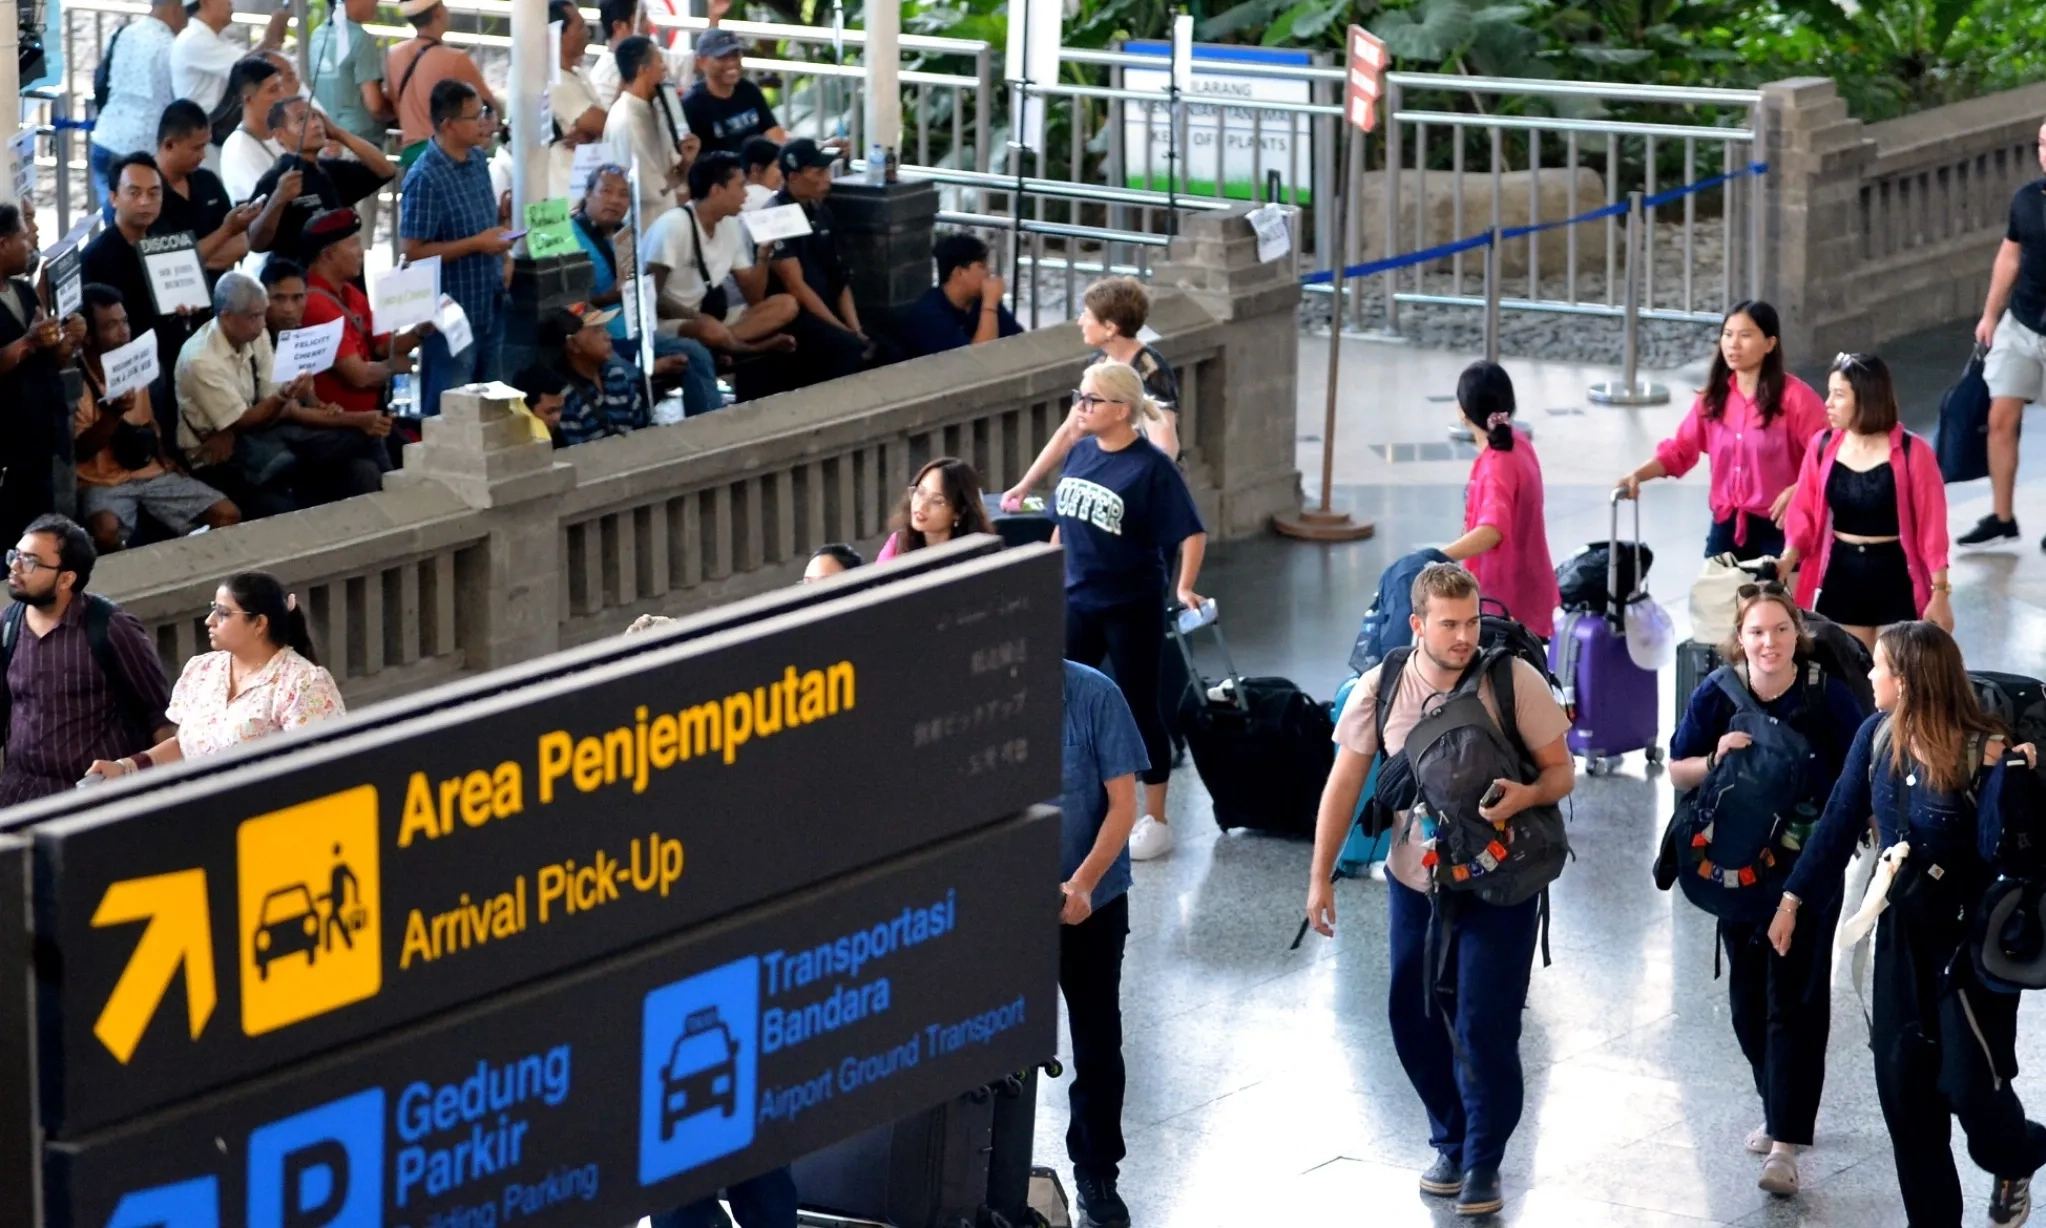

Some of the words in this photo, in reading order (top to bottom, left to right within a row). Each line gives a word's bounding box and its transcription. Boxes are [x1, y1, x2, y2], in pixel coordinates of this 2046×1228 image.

[1190, 80, 1253, 98] ILARANG
[1228, 134, 1287, 151] PLANTS
[140, 233, 194, 253] DISCOVA
[397, 771, 523, 848] Area
[538, 660, 855, 803] Penjemputan
[399, 875, 527, 970] Arrival
[537, 831, 684, 923] Pick-Up
[763, 887, 955, 996] Transportasi
[759, 1069, 834, 1123] Airport
[838, 1032, 920, 1092] Ground
[925, 993, 1026, 1058] Transport
[762, 976, 892, 1054] Bandara
[397, 1043, 571, 1142] Gedung
[396, 1113, 528, 1207] Parkir
[503, 1162, 598, 1222] Parking
